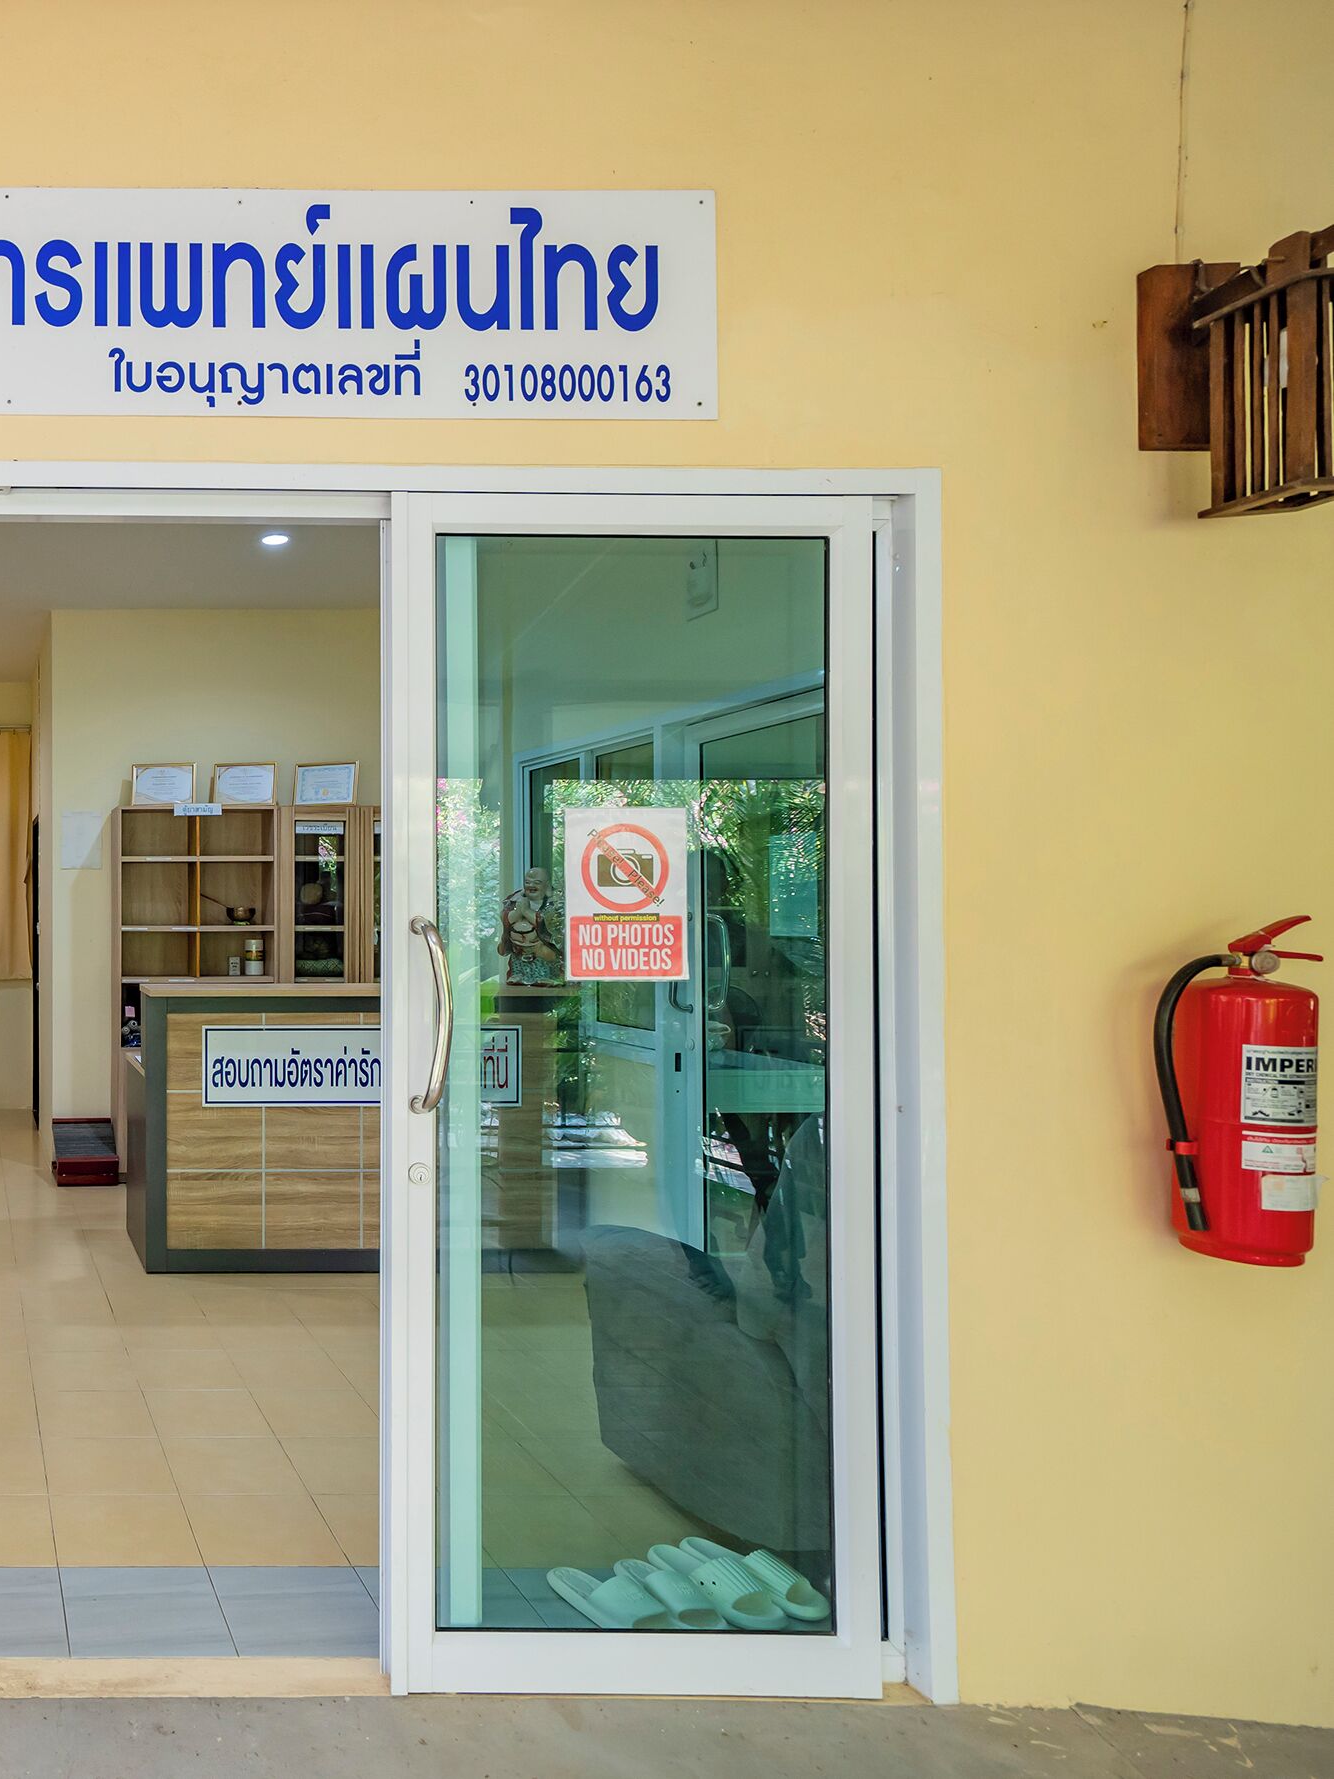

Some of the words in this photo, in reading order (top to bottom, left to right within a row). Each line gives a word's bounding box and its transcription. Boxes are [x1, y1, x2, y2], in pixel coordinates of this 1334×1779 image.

[108, 338, 421, 407] ใบอนุญาตเลขที่
[464, 363, 672, 402] 30108000163
[594, 914, 619, 922] without
[619, 913, 657, 923] permission
[578, 924, 602, 946] NO
[607, 924, 675, 946] PHOTOS
[581, 948, 605, 970] NO
[609, 948, 672, 970] VIDEOS
[212, 1045, 381, 1088] สอบถามอัตราค่ารัก
